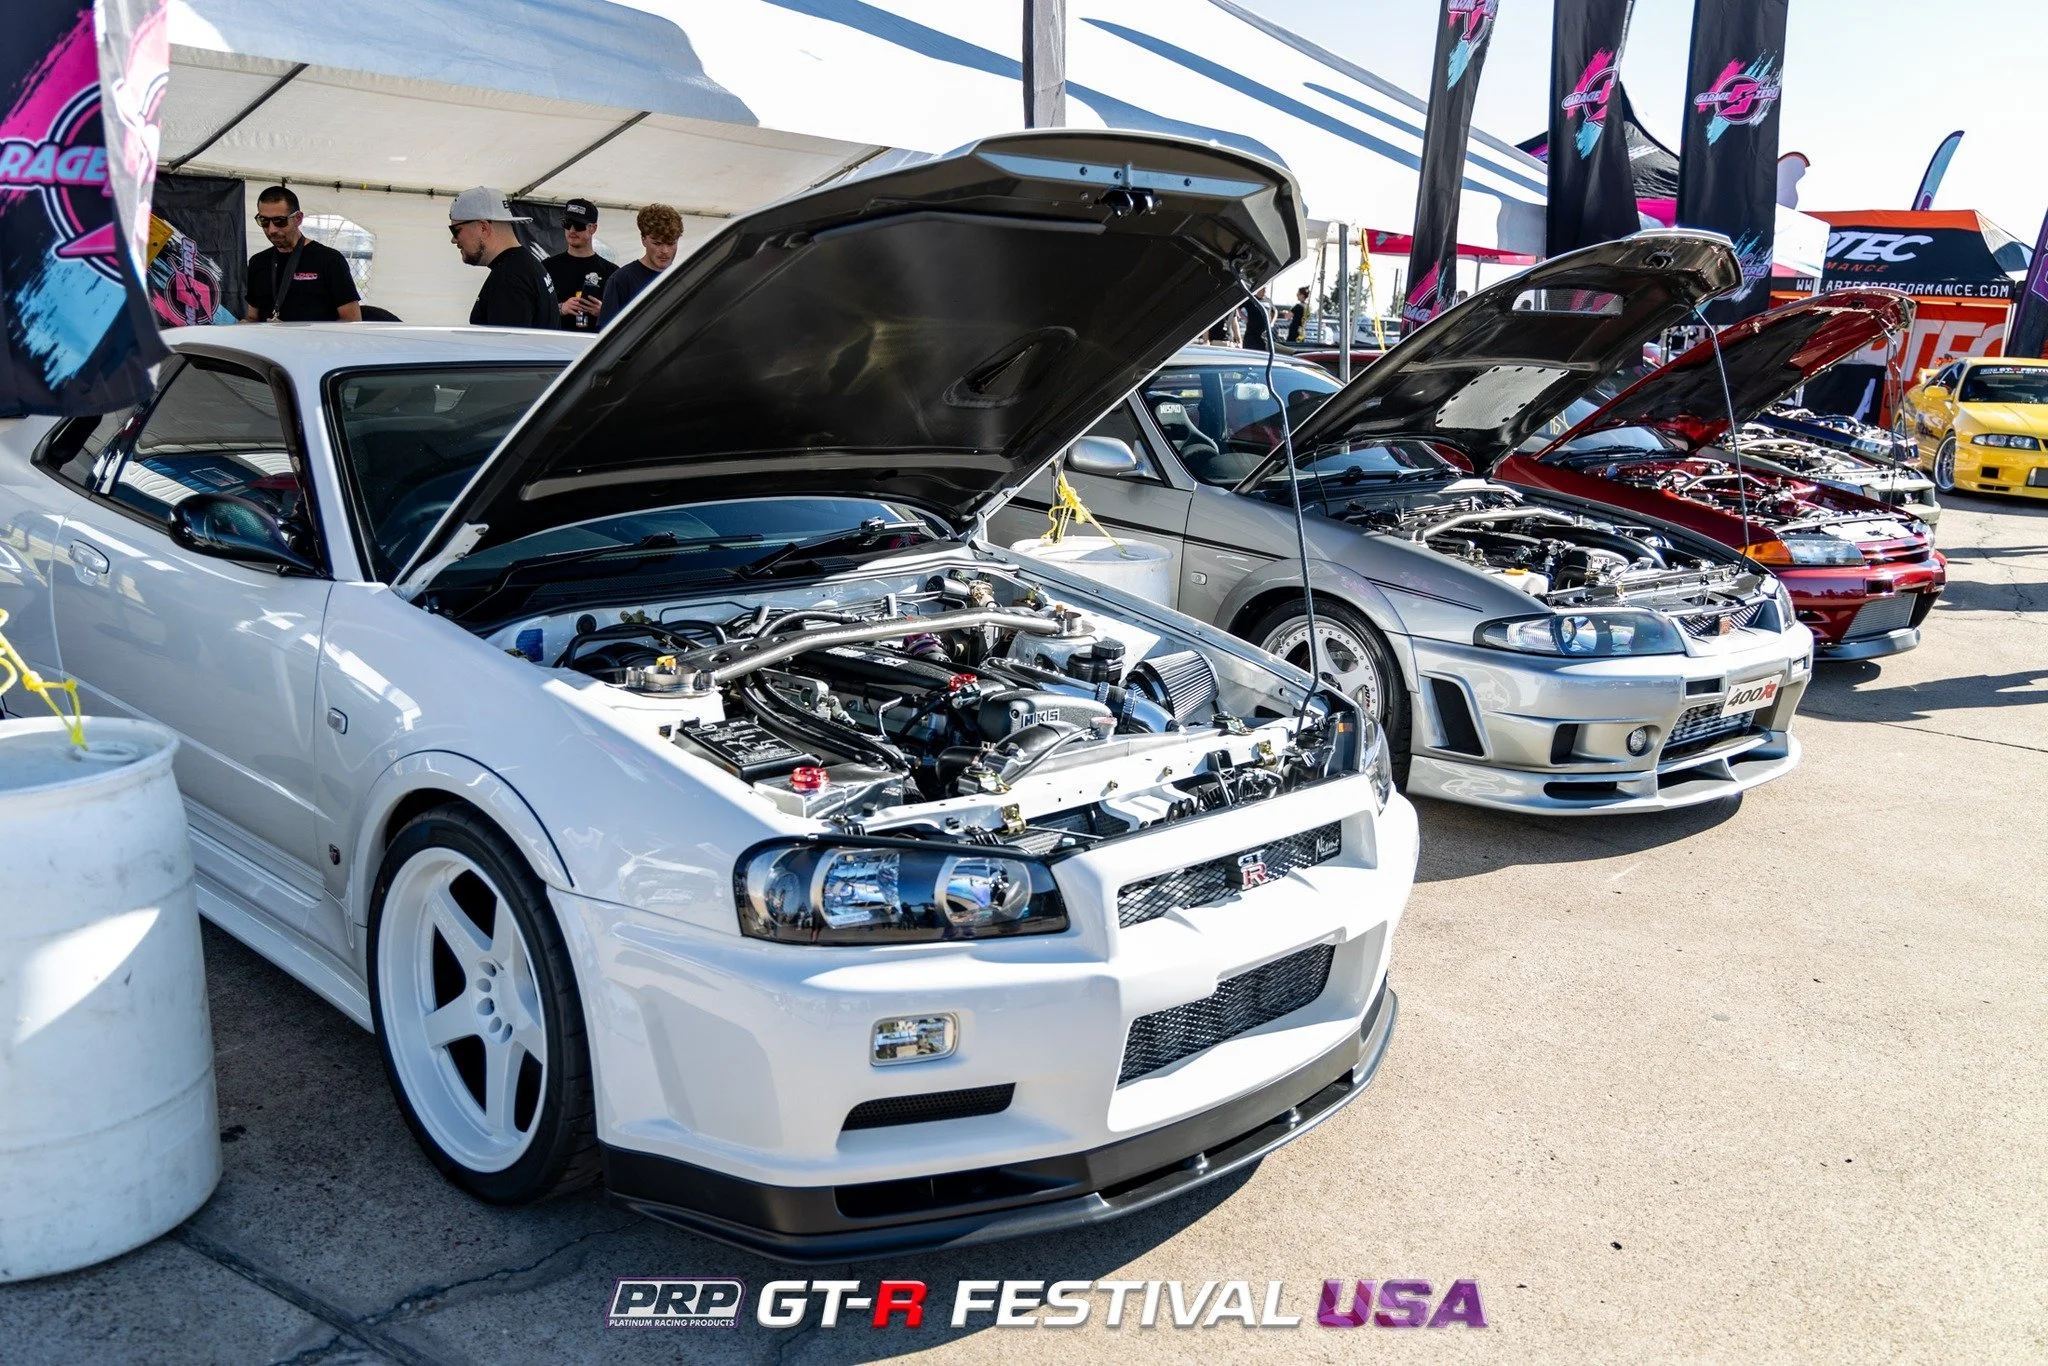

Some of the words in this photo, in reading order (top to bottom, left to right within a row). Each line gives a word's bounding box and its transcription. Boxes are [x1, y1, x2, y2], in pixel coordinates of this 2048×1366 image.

[1564, 91, 1602, 107] GARAGE
[1696, 91, 1732, 103] GARAGE
[1755, 86, 1780, 99] ZERO
[1742, 265, 1767, 277] ERO
[1593, 557, 1609, 565] HKS
[1728, 682, 1777, 707] 400R
[1022, 708, 1060, 728] HKS
